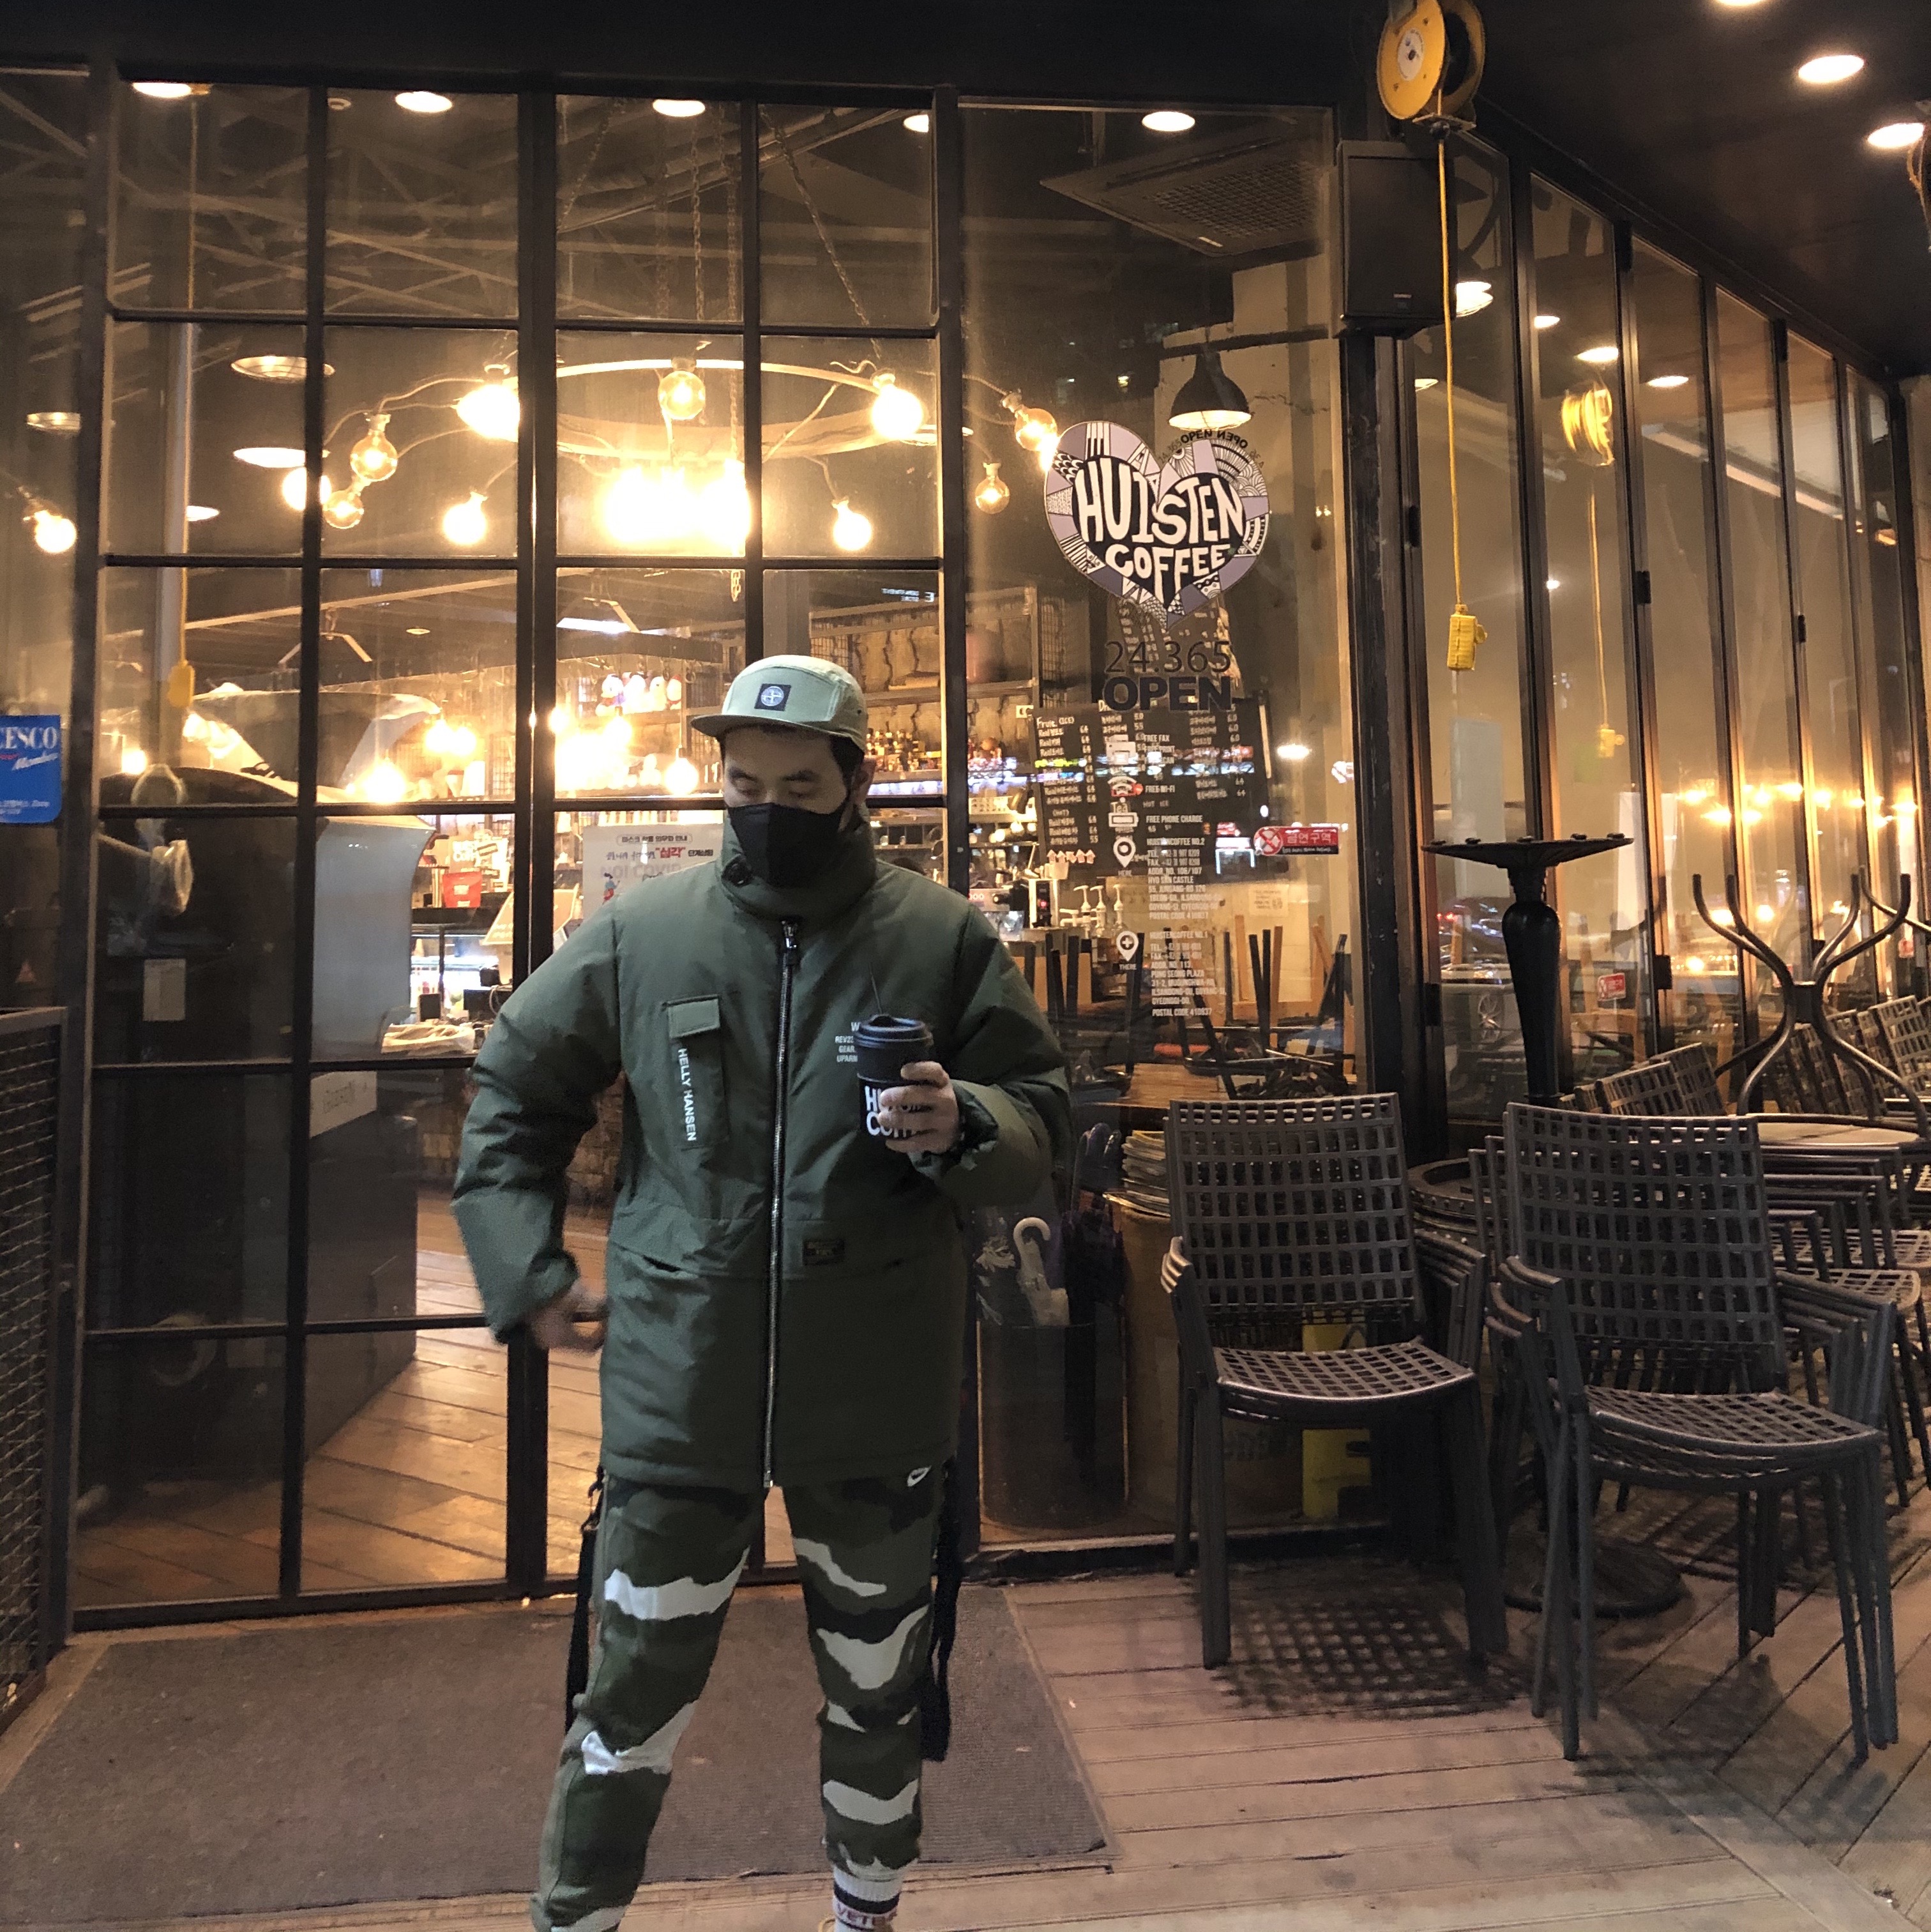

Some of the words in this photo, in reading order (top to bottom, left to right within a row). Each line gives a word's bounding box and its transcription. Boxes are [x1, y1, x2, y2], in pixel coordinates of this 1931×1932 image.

[1181, 429, 1213, 444] OPEN
[1074, 457, 1243, 545] HUISTEN
[1105, 543, 1231, 604] COFFEE
[1105, 641, 1232, 673] 24.365
[1103, 676, 1232, 711] OPEN
[1110, 802, 1128, 812] Tea
[1287, 832, 1331, 844] 금연구역
[678, 1048, 692, 1086] HELLY
[683, 1090, 697, 1141] HANSEN
